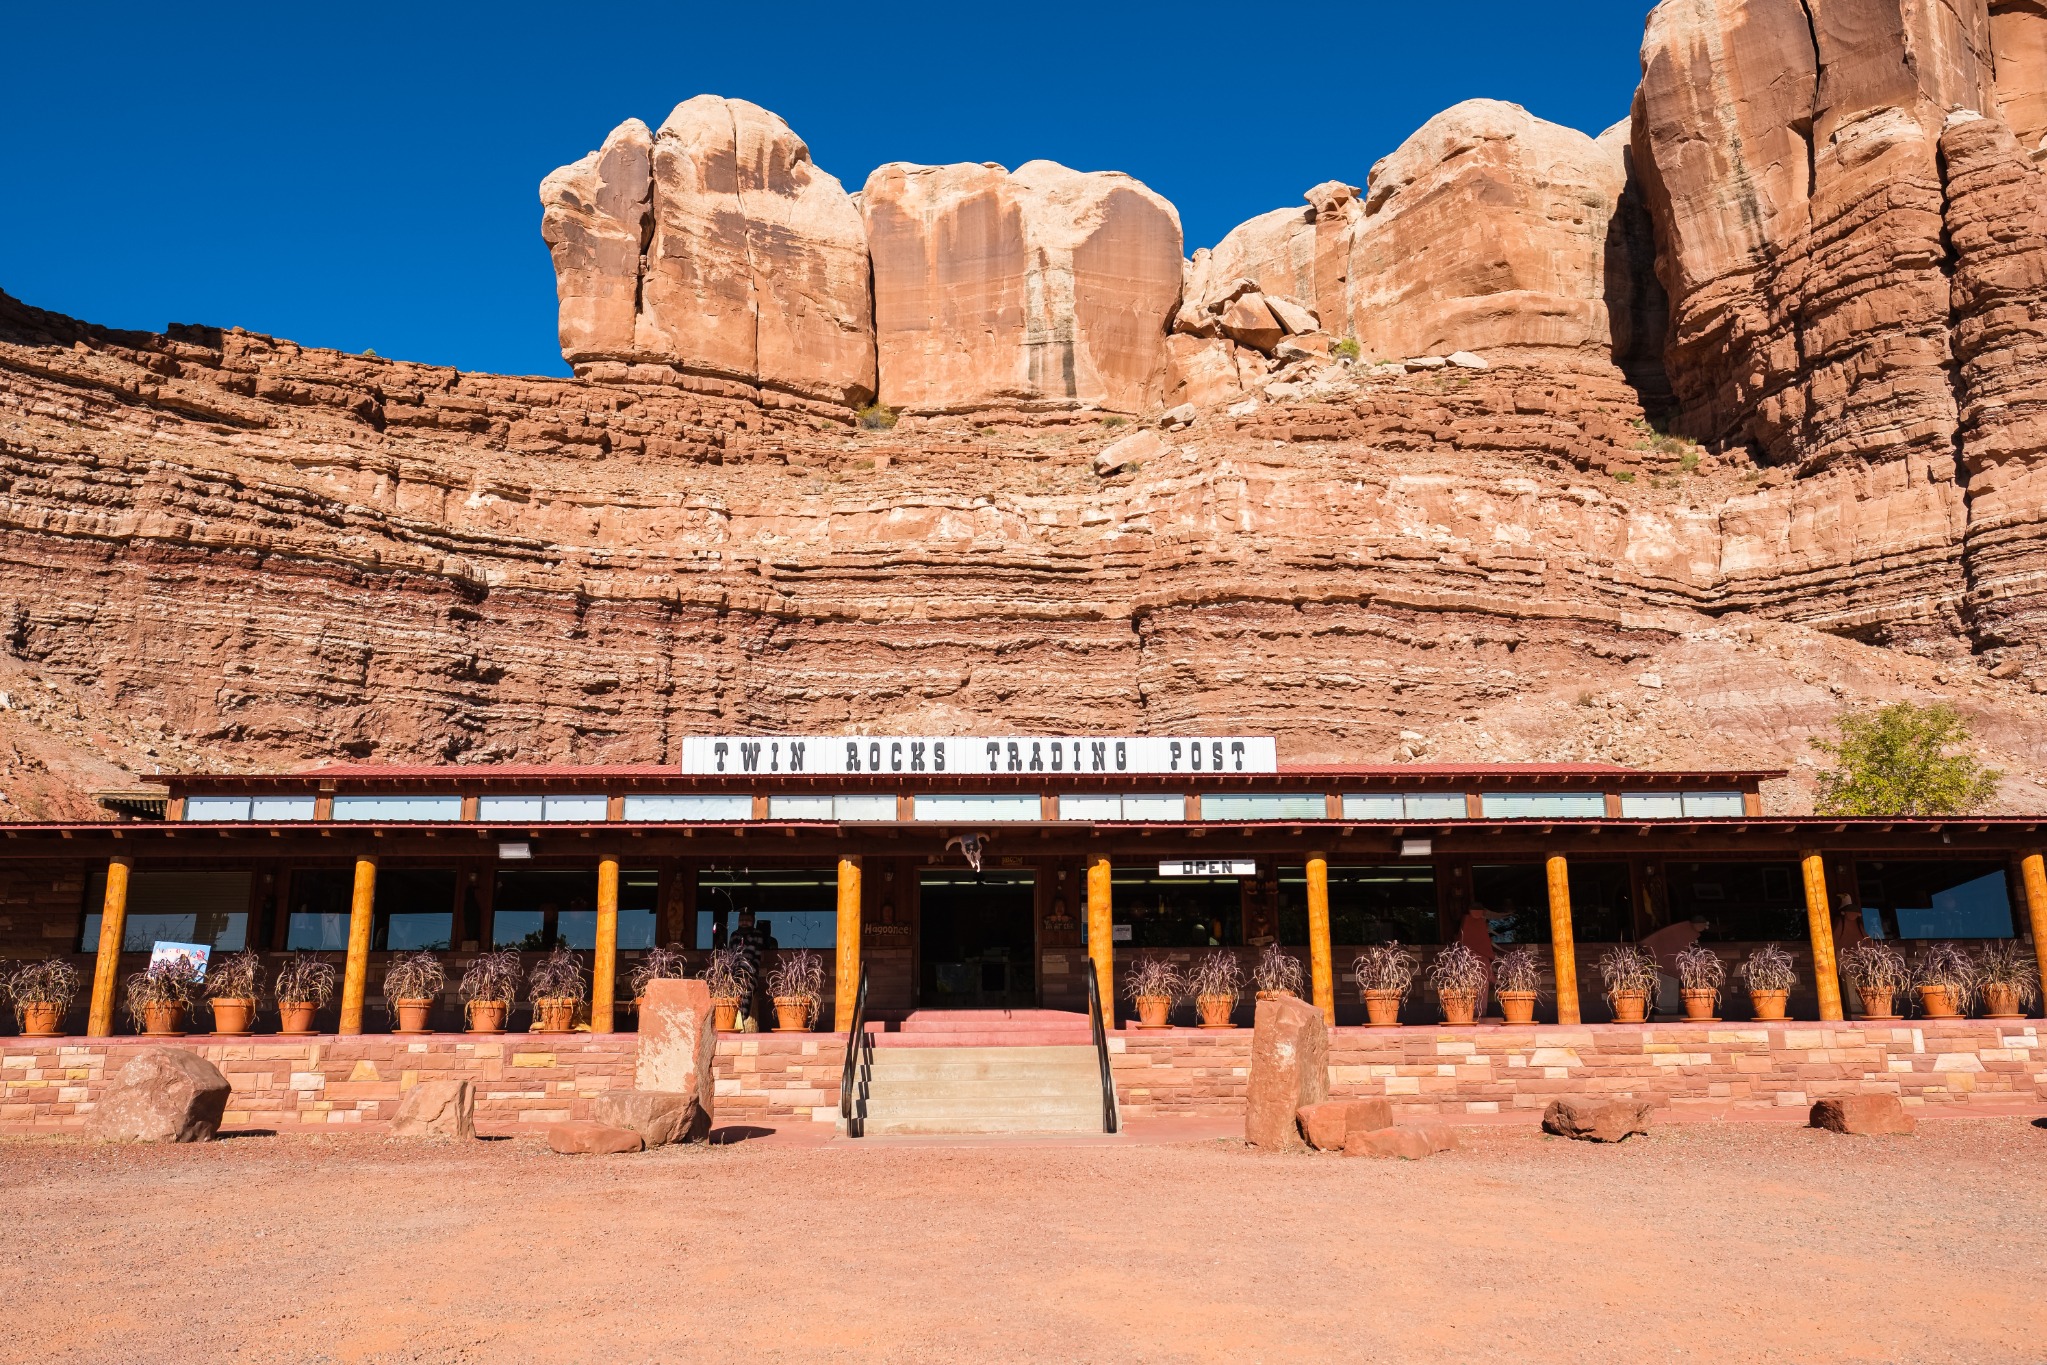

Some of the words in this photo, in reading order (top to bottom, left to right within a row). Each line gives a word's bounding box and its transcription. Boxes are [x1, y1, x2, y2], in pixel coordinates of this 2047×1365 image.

[714, 742, 806, 772] TWIN
[846, 742, 946, 772] ROCKS
[987, 741, 1127, 772] TRADING
[1170, 741, 1245, 771] POST
[1182, 860, 1233, 875] OPEN
